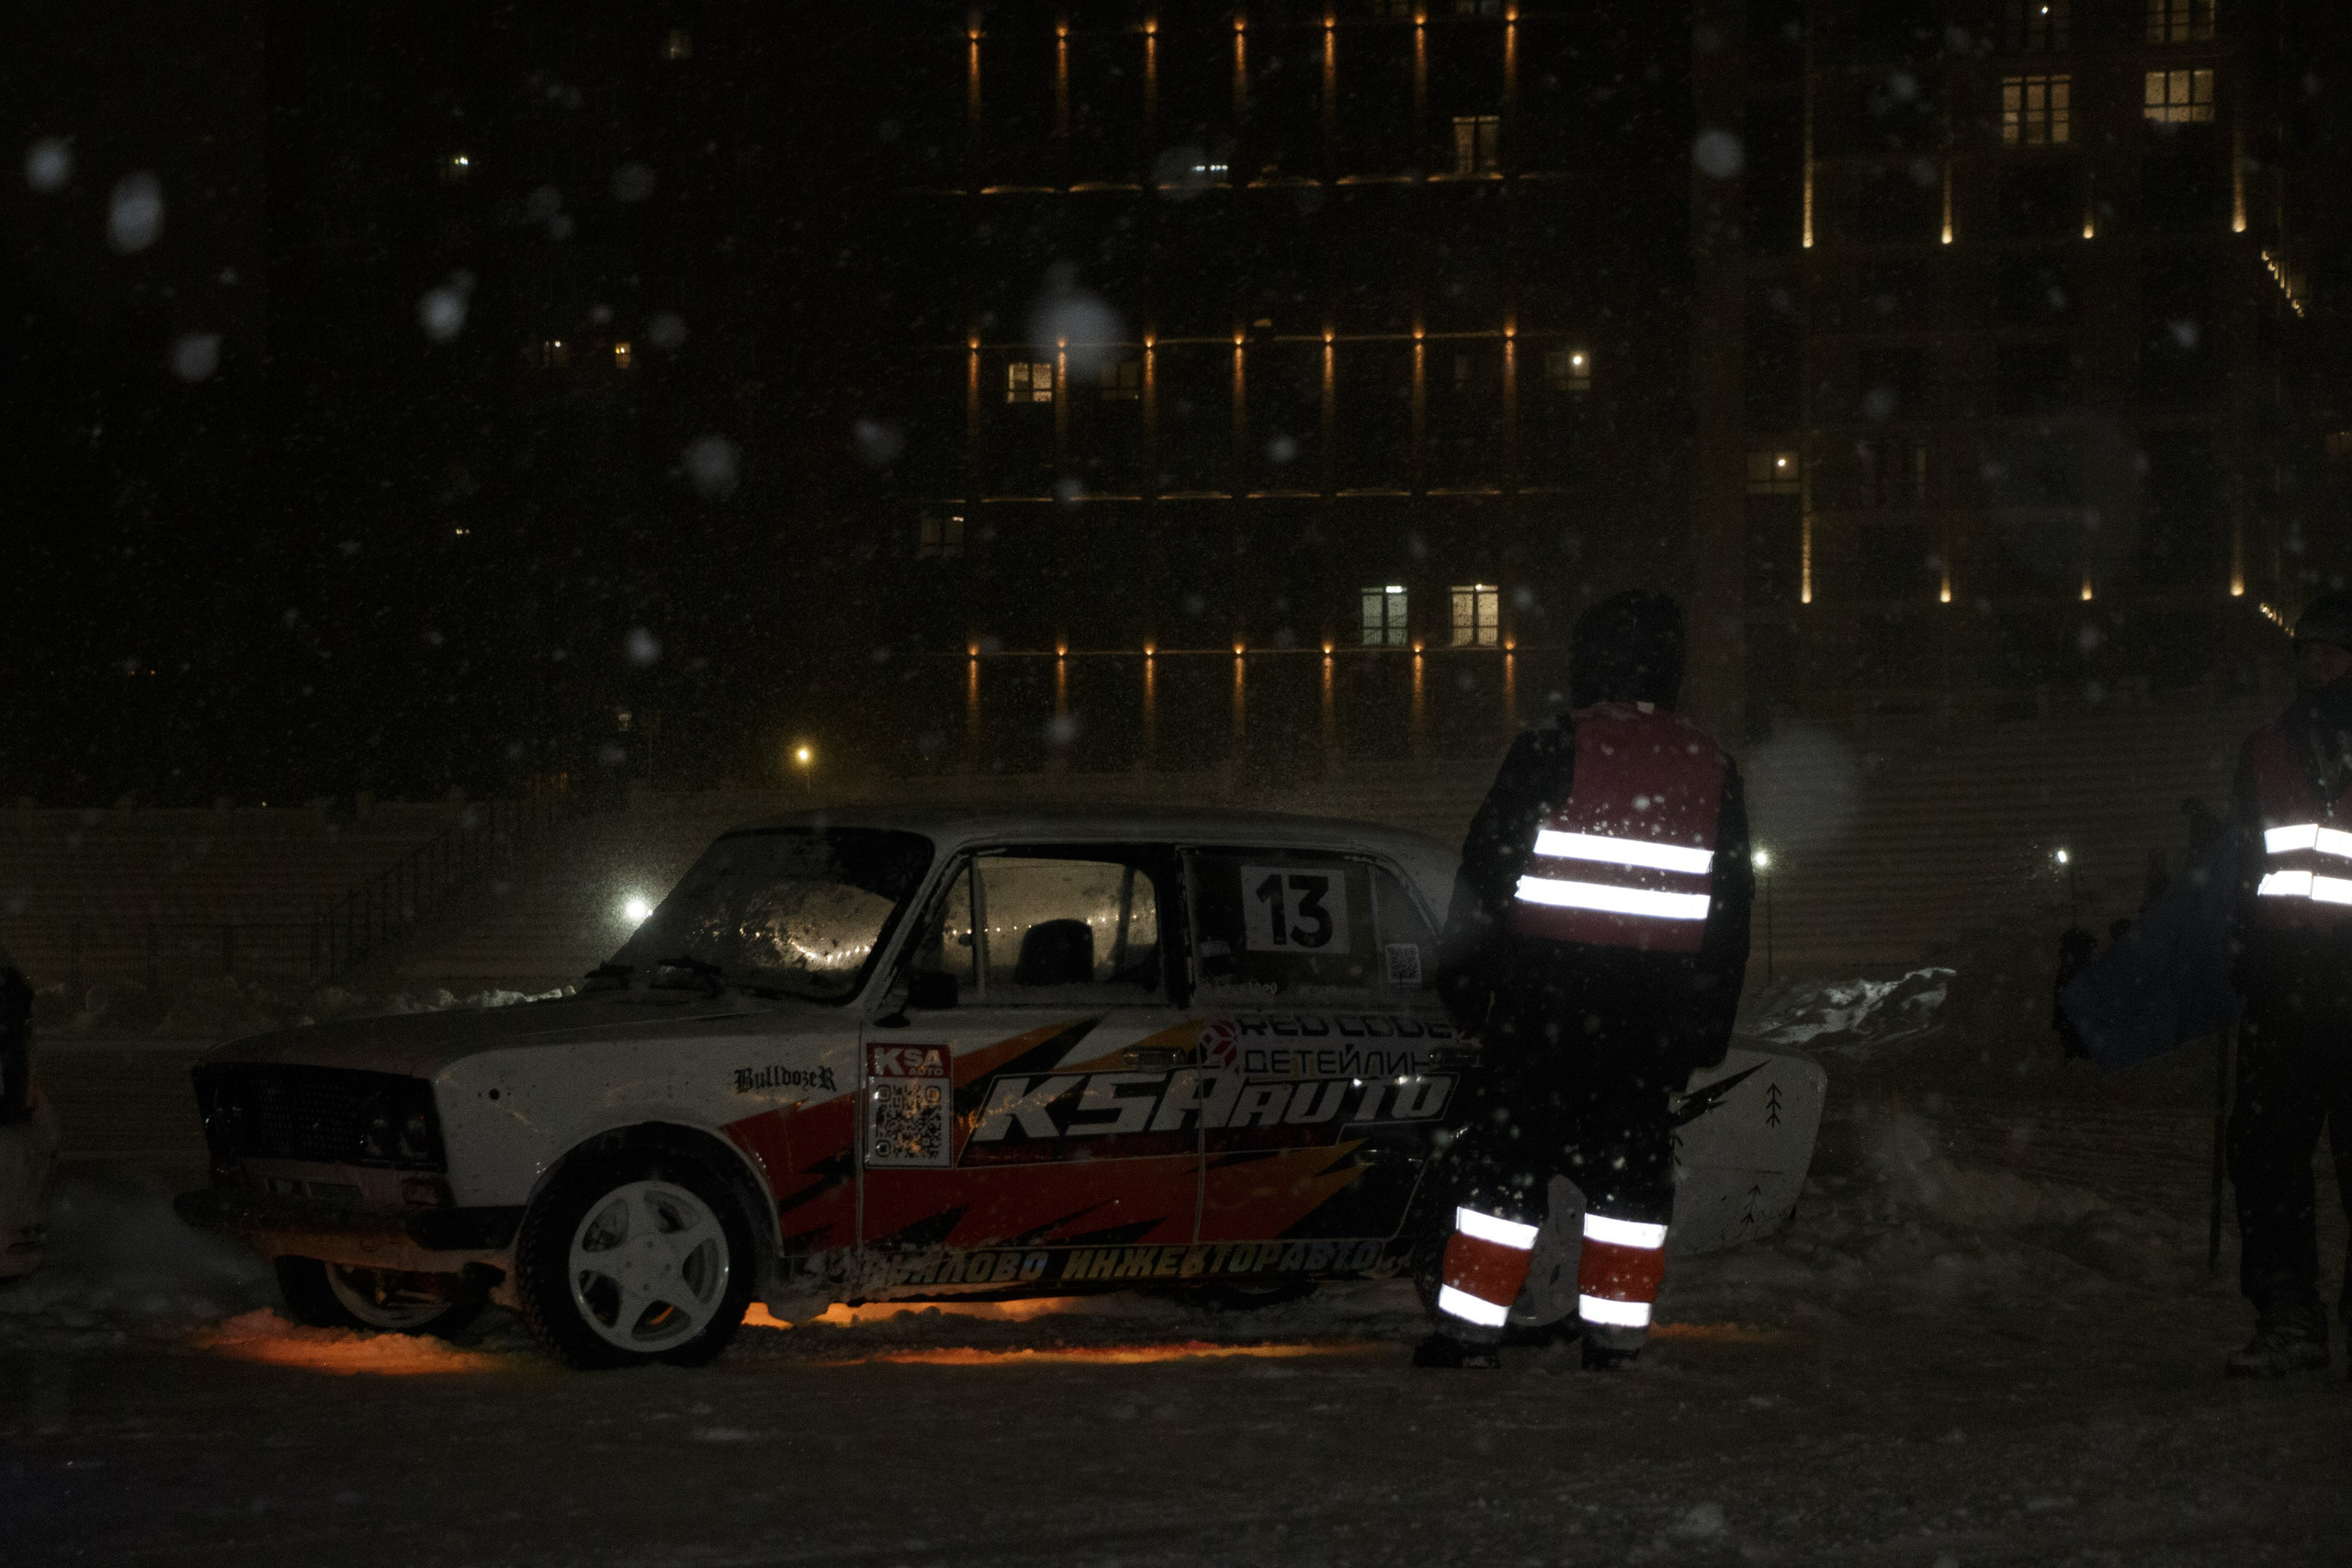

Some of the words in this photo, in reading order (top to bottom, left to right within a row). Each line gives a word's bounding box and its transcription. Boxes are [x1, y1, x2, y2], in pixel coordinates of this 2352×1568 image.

[1255, 873, 1334, 949] 13
[873, 1046, 944, 1076] KSA
[908, 1067, 945, 1077] AUTO
[1243, 1044, 1431, 1076] ДЕТЕЙЛИН
